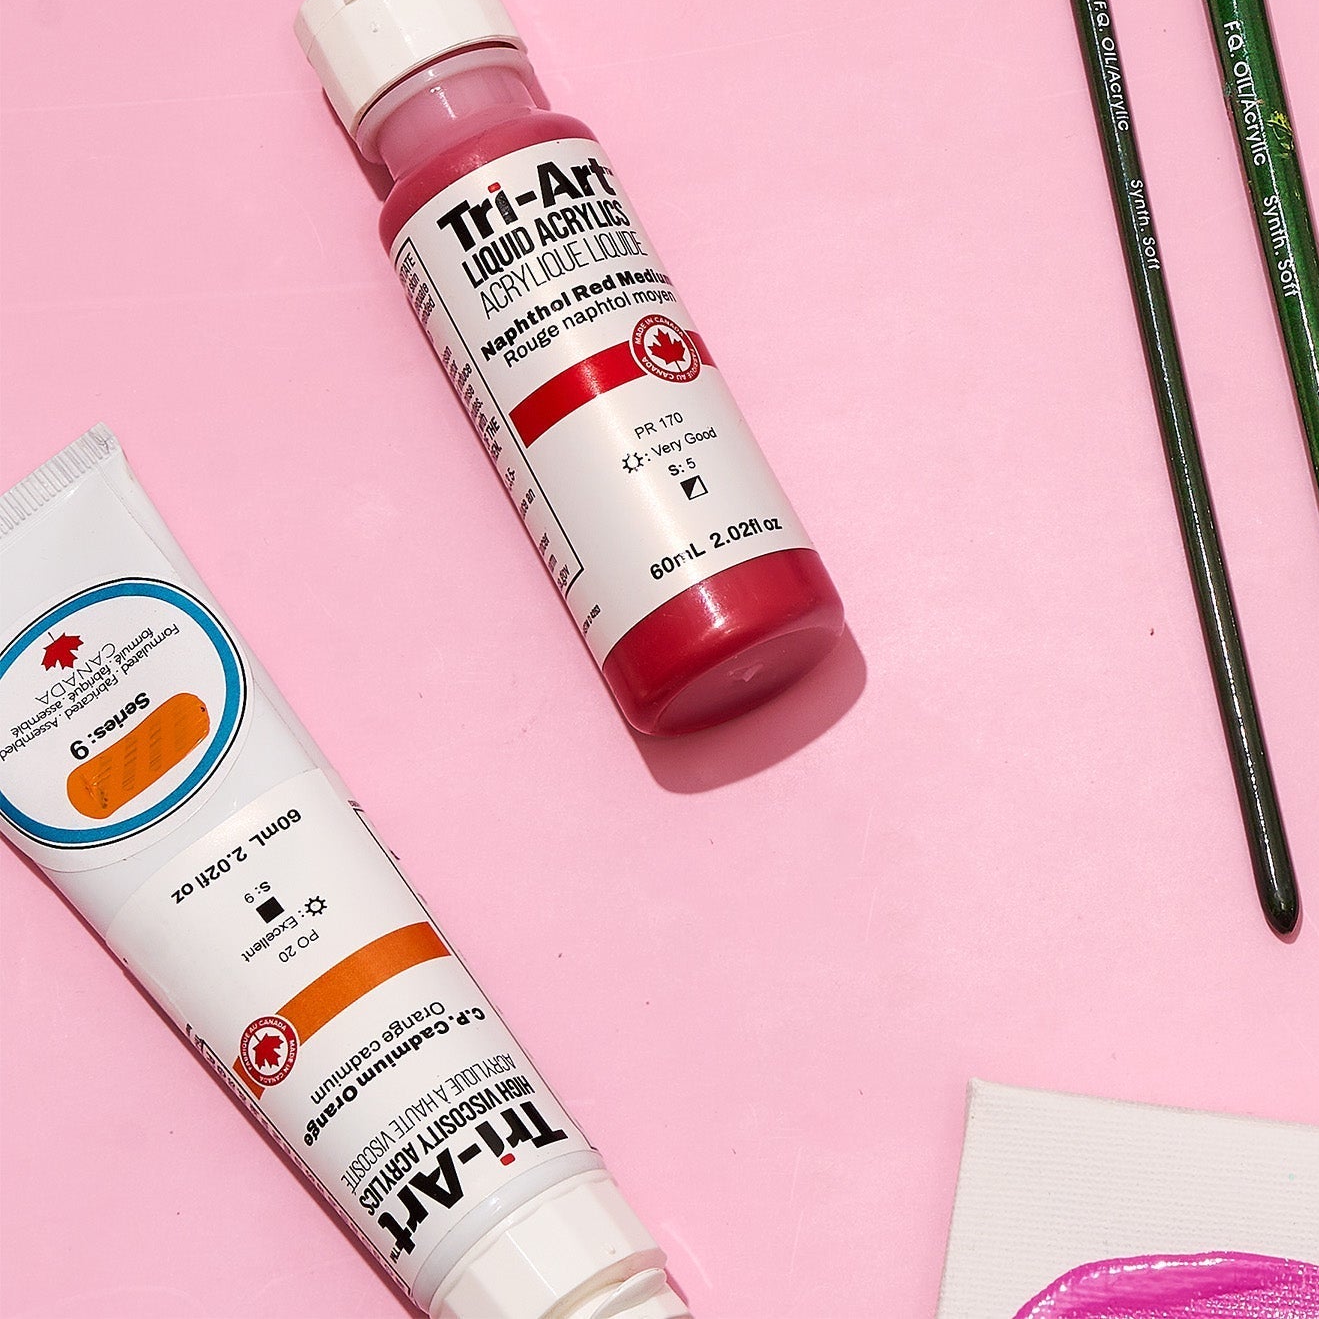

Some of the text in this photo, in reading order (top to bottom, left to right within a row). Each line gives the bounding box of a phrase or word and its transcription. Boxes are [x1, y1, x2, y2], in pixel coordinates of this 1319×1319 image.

[1093, 0, 1130, 132] F.Q. OIL/Acrylic
[1223, 20, 1267, 167] F.Q. OIL/Acrylic
[461, 225, 536, 288] LIQUID
[535, 200, 630, 247] ACRYLICS
[1130, 179, 1161, 271] Synth. Soft
[1263, 195, 1300, 298] Synth. Soft
[479, 248, 589, 320] ACRYLIQUE
[584, 231, 648, 266] LIQUIDE
[480, 268, 674, 362] Naphthol Red Medium
[503, 290, 677, 367] Rouge naphtol moyen
[634, 412, 683, 439] PR 170
[651, 427, 718, 458] Very Good
[650, 542, 706, 580] 60mL
[0, 623, 180, 761] Formulated Fabricated Assembled
[11, 627, 154, 738] formulé fabriqué assemblé
[35, 643, 116, 705] CANADA
[70, 692, 150, 760] Series: 9
[170, 808, 302, 904] 60mL oz
[241, 916, 298, 963] Excellent
[278, 929, 320, 963] PO 20
[303, 1021, 450, 1146] Cadmium Orange
[310, 1000, 445, 1104] Orange cadmium
[340, 1053, 517, 1196] ACRYLIQUE HAUTE VISCOSITÉ
[358, 1075, 535, 1217] HIGH VISCOSITY ACRYLICS
